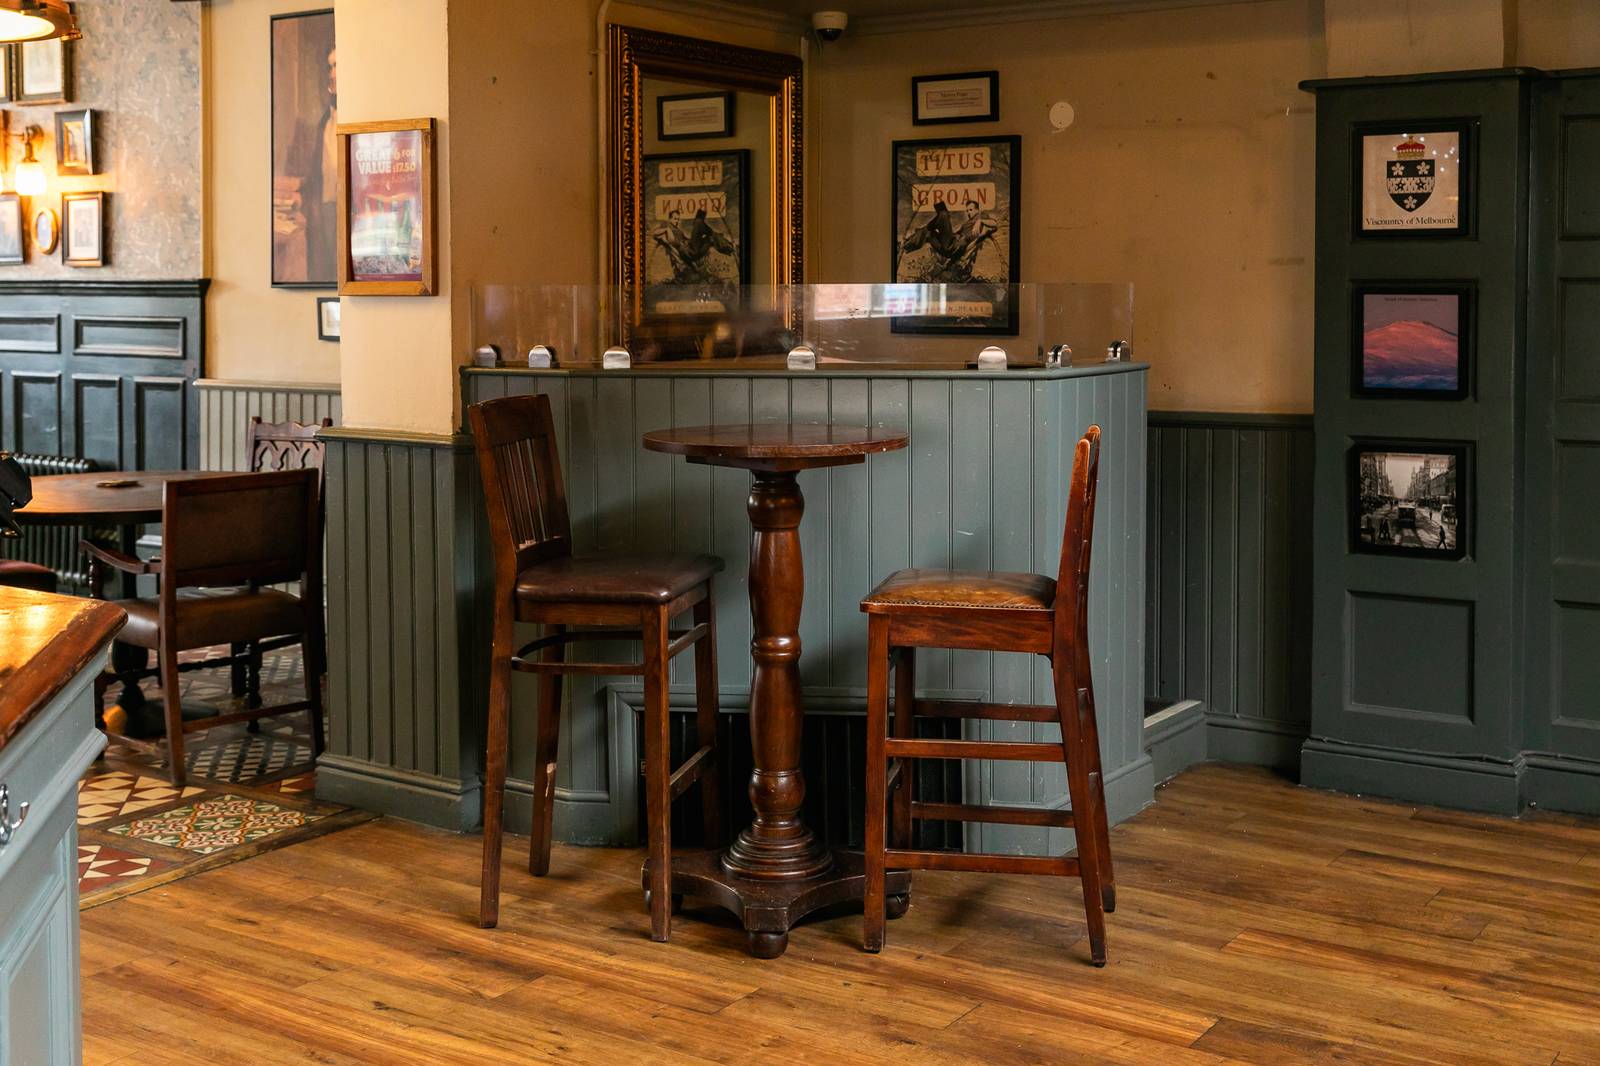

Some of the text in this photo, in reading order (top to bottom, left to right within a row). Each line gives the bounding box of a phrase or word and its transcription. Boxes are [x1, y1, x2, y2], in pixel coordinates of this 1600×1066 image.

[358, 161, 392, 174] VALUE
[921, 152, 984, 171] TITUS
[917, 188, 987, 206] GROAN
[1406, 216, 1414, 225] of
[1415, 215, 1456, 225] Melbourne
